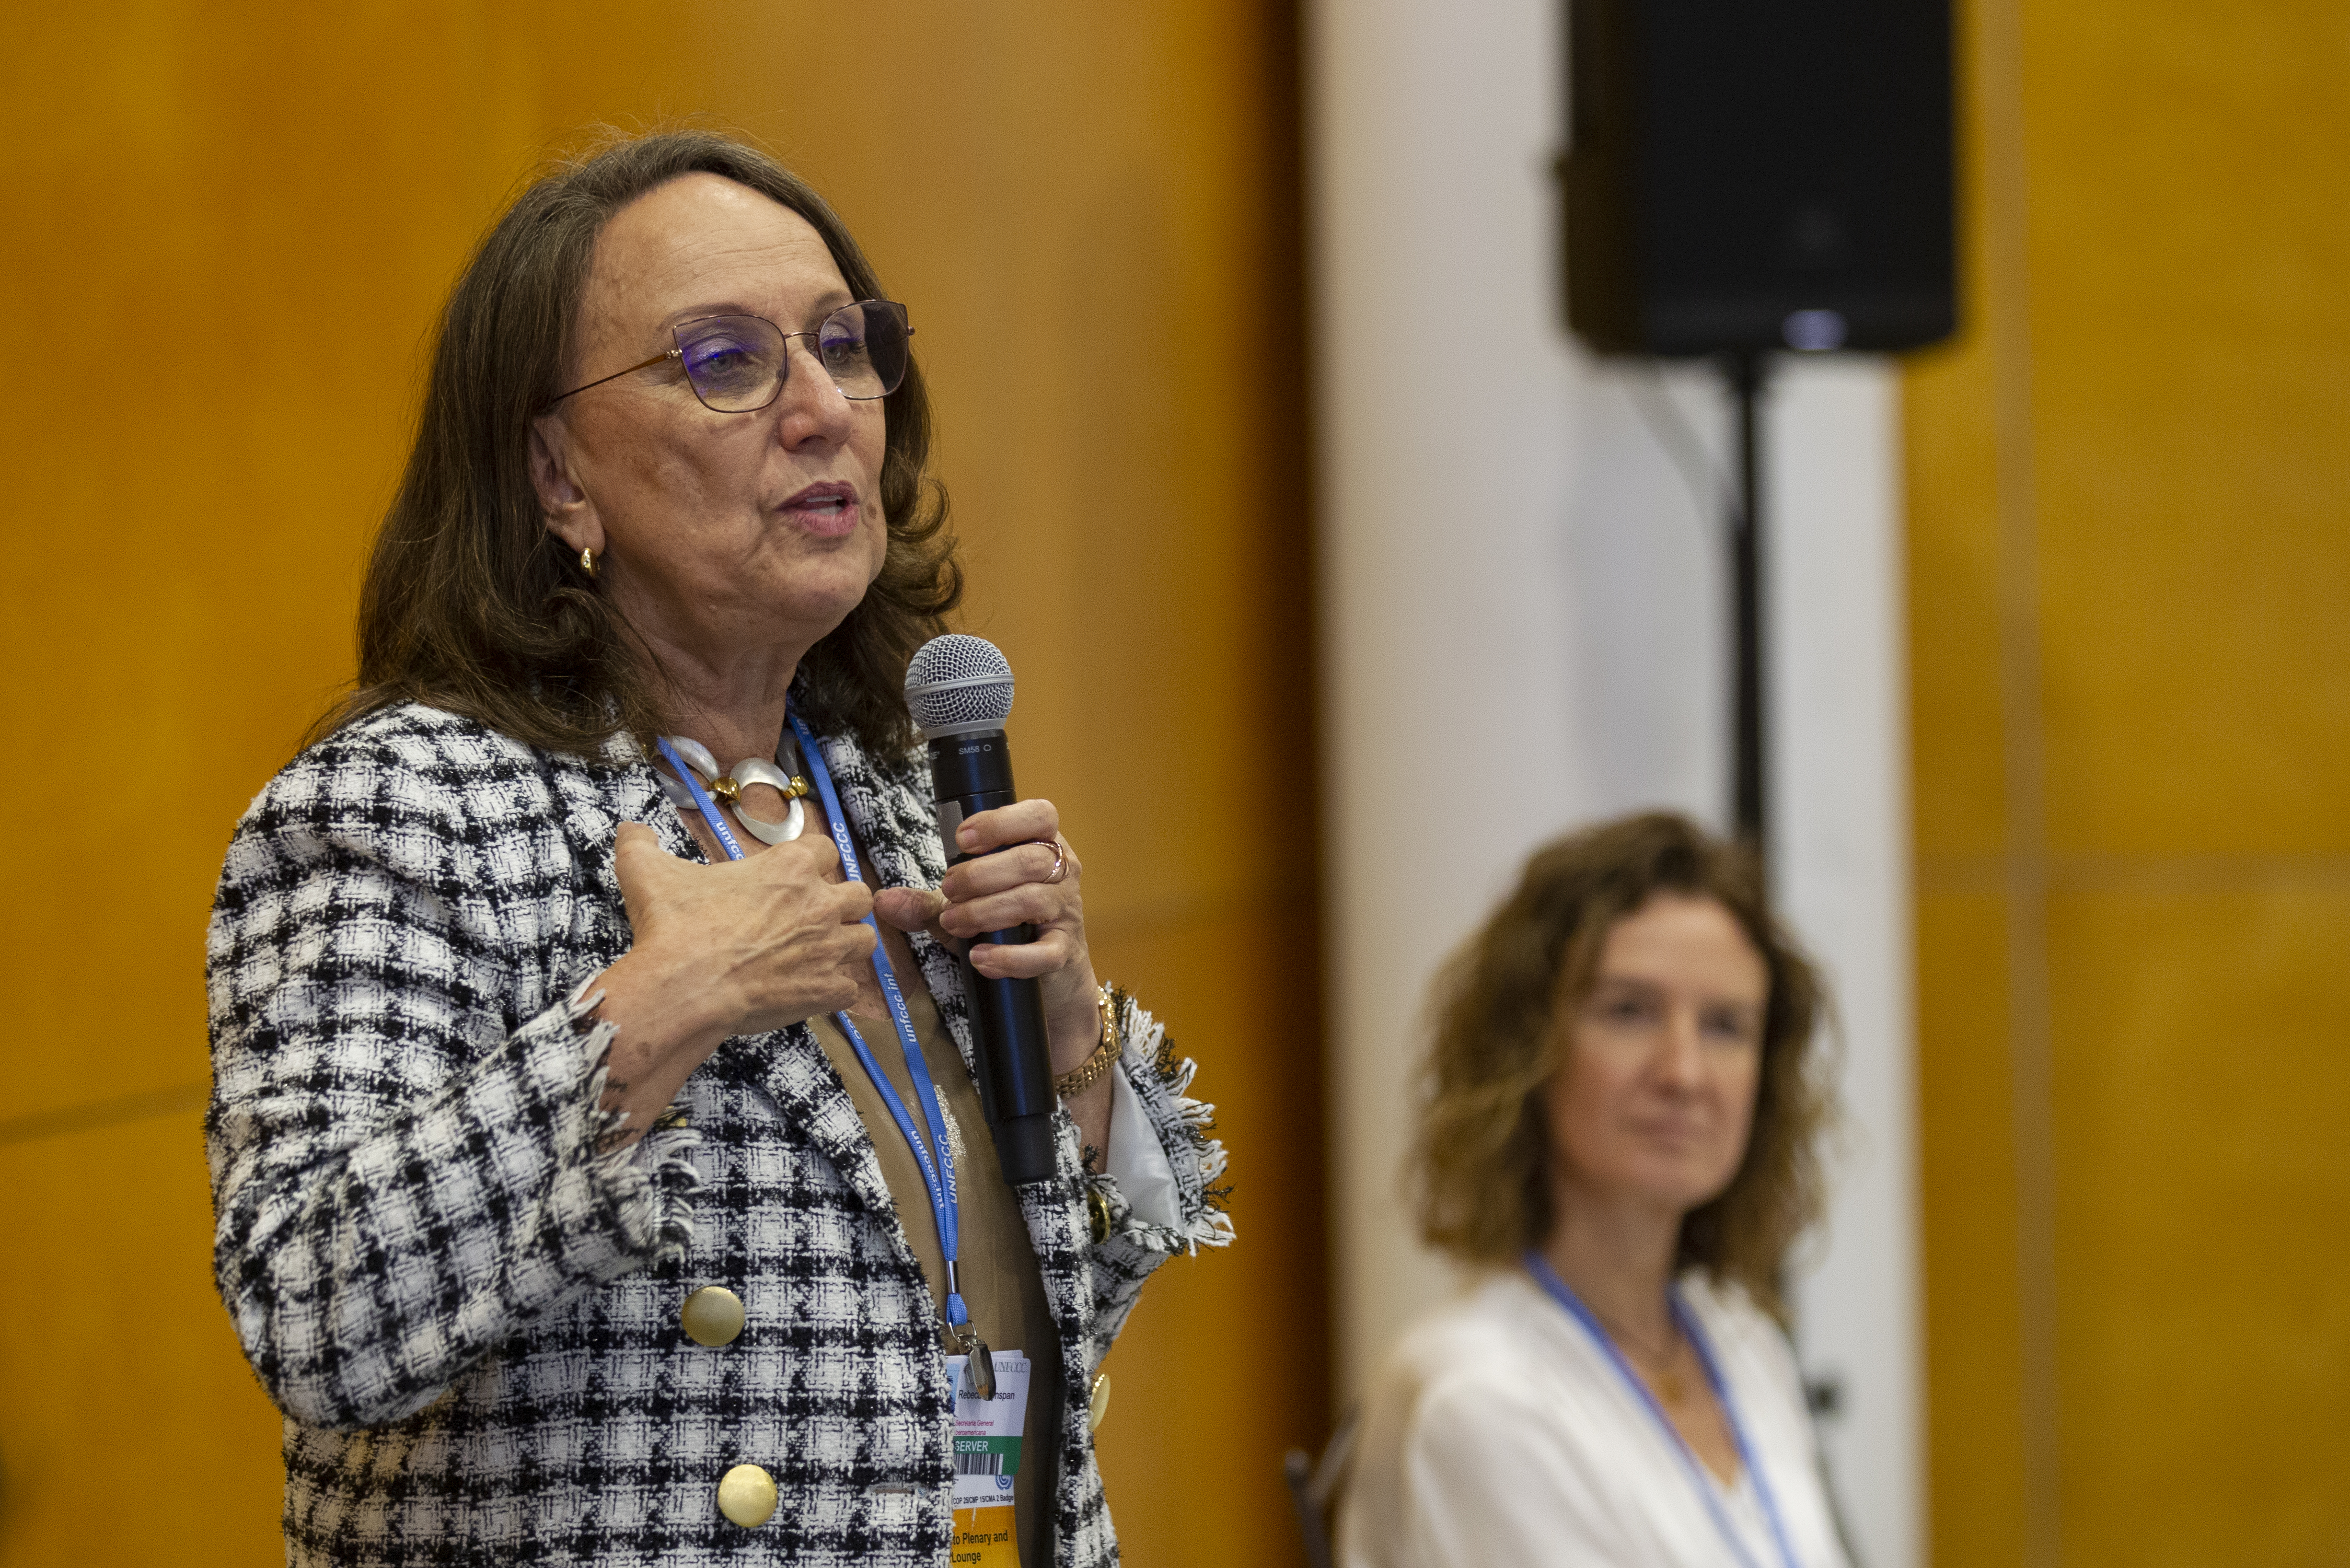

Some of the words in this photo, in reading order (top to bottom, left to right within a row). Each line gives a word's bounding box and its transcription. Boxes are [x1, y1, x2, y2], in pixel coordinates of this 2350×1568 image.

[958, 746, 980, 755] SM58
[884, 972, 917, 1042] unfccc.int
[938, 1134, 957, 1204] UNFCCC
[1000, 1494, 1014, 1503] Badge
[963, 1532, 991, 1546] Plenary
[993, 1529, 1009, 1542] and
[951, 1551, 981, 1565] Lounge
